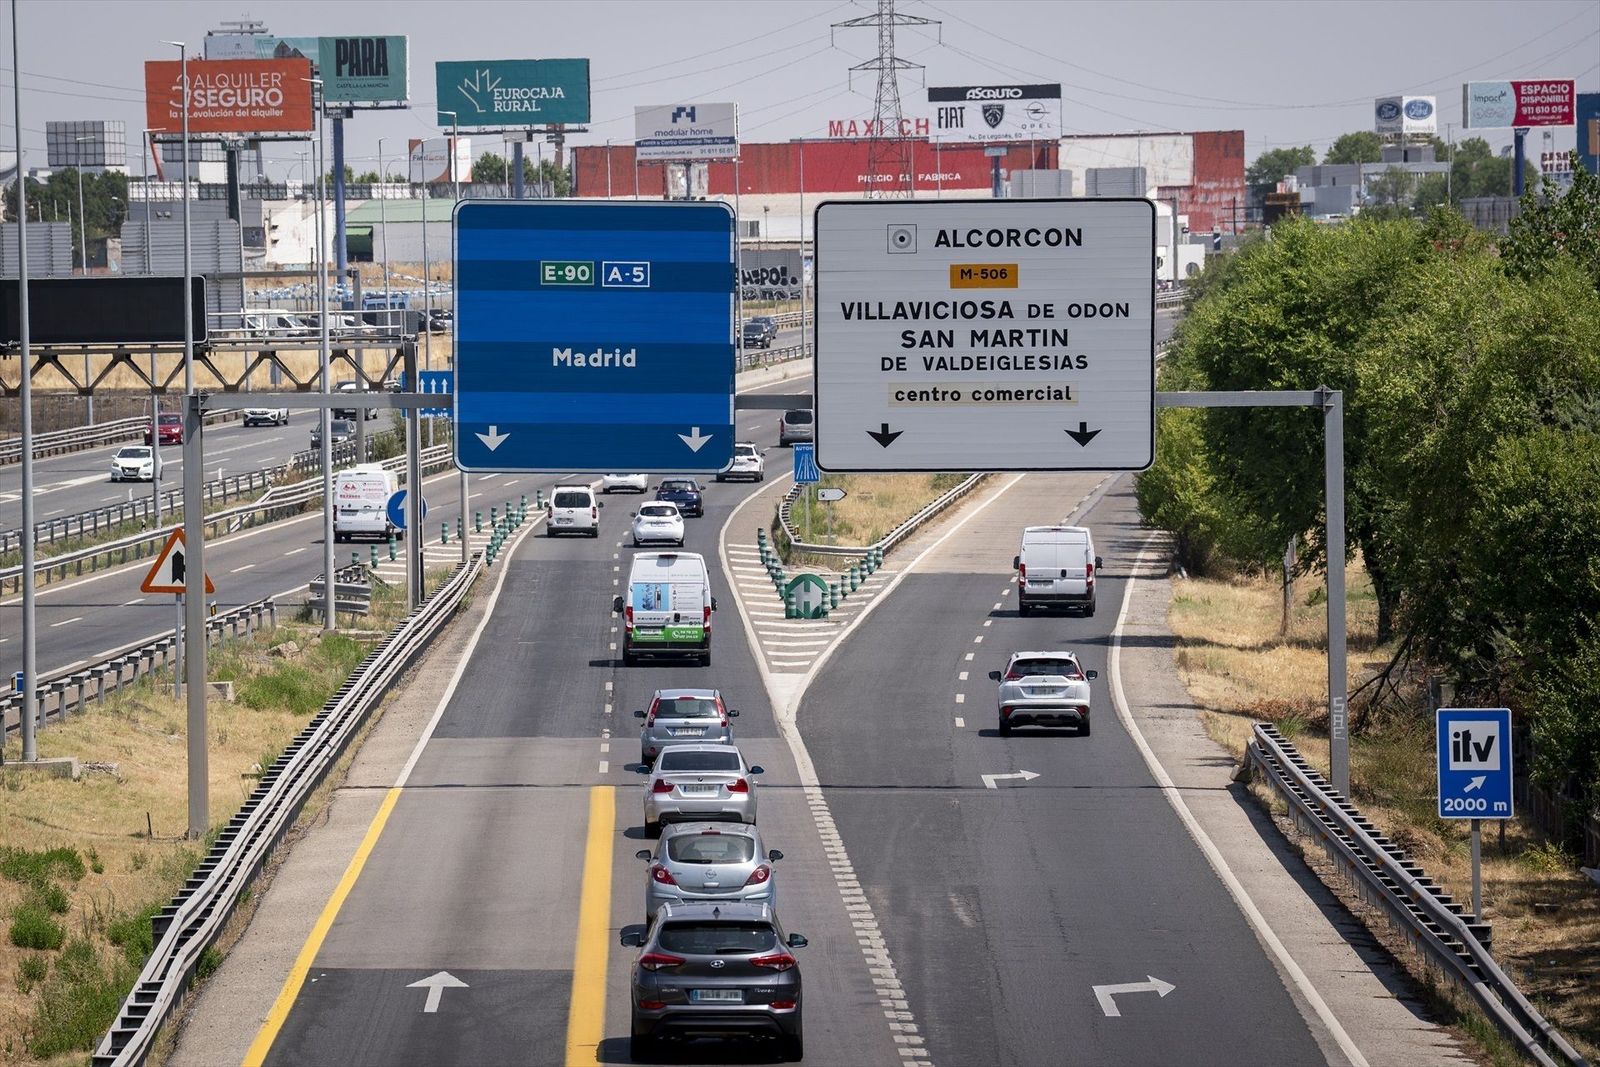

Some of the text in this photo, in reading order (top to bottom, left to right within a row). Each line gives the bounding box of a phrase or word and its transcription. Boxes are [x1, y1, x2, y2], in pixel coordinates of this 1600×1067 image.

[335, 37, 389, 77] PARA
[193, 72, 282, 89] ALQUILER
[193, 87, 284, 108] SEGURO
[493, 87, 566, 100] EUROCAJA
[1520, 84, 1570, 95] ESPACIO
[493, 100, 542, 112] RURAL
[1520, 94, 1570, 105] DISPONIBLE
[169, 109, 179, 119] la
[235, 108, 250, 117] del
[251, 108, 284, 118] alquiler
[937, 107, 966, 129] FIAT
[654, 128, 714, 137] modular home
[918, 172, 961, 182] FABRICA
[934, 227, 1083, 248] ALCORCON
[544, 264, 591, 282] E-90
[607, 266, 645, 283] A-5
[959, 267, 1009, 281] M-506
[840, 300, 1130, 321] VILLAVICIOSA DE ODON
[900, 328, 1069, 349] SAN MARTIN
[552, 347, 637, 368] Madrid
[880, 354, 1089, 372] DE VALDEIGLESIAS
[894, 384, 1073, 402] centro comercial
[1452, 729, 1496, 763] itv
[1444, 797, 1508, 812] 2000 m
